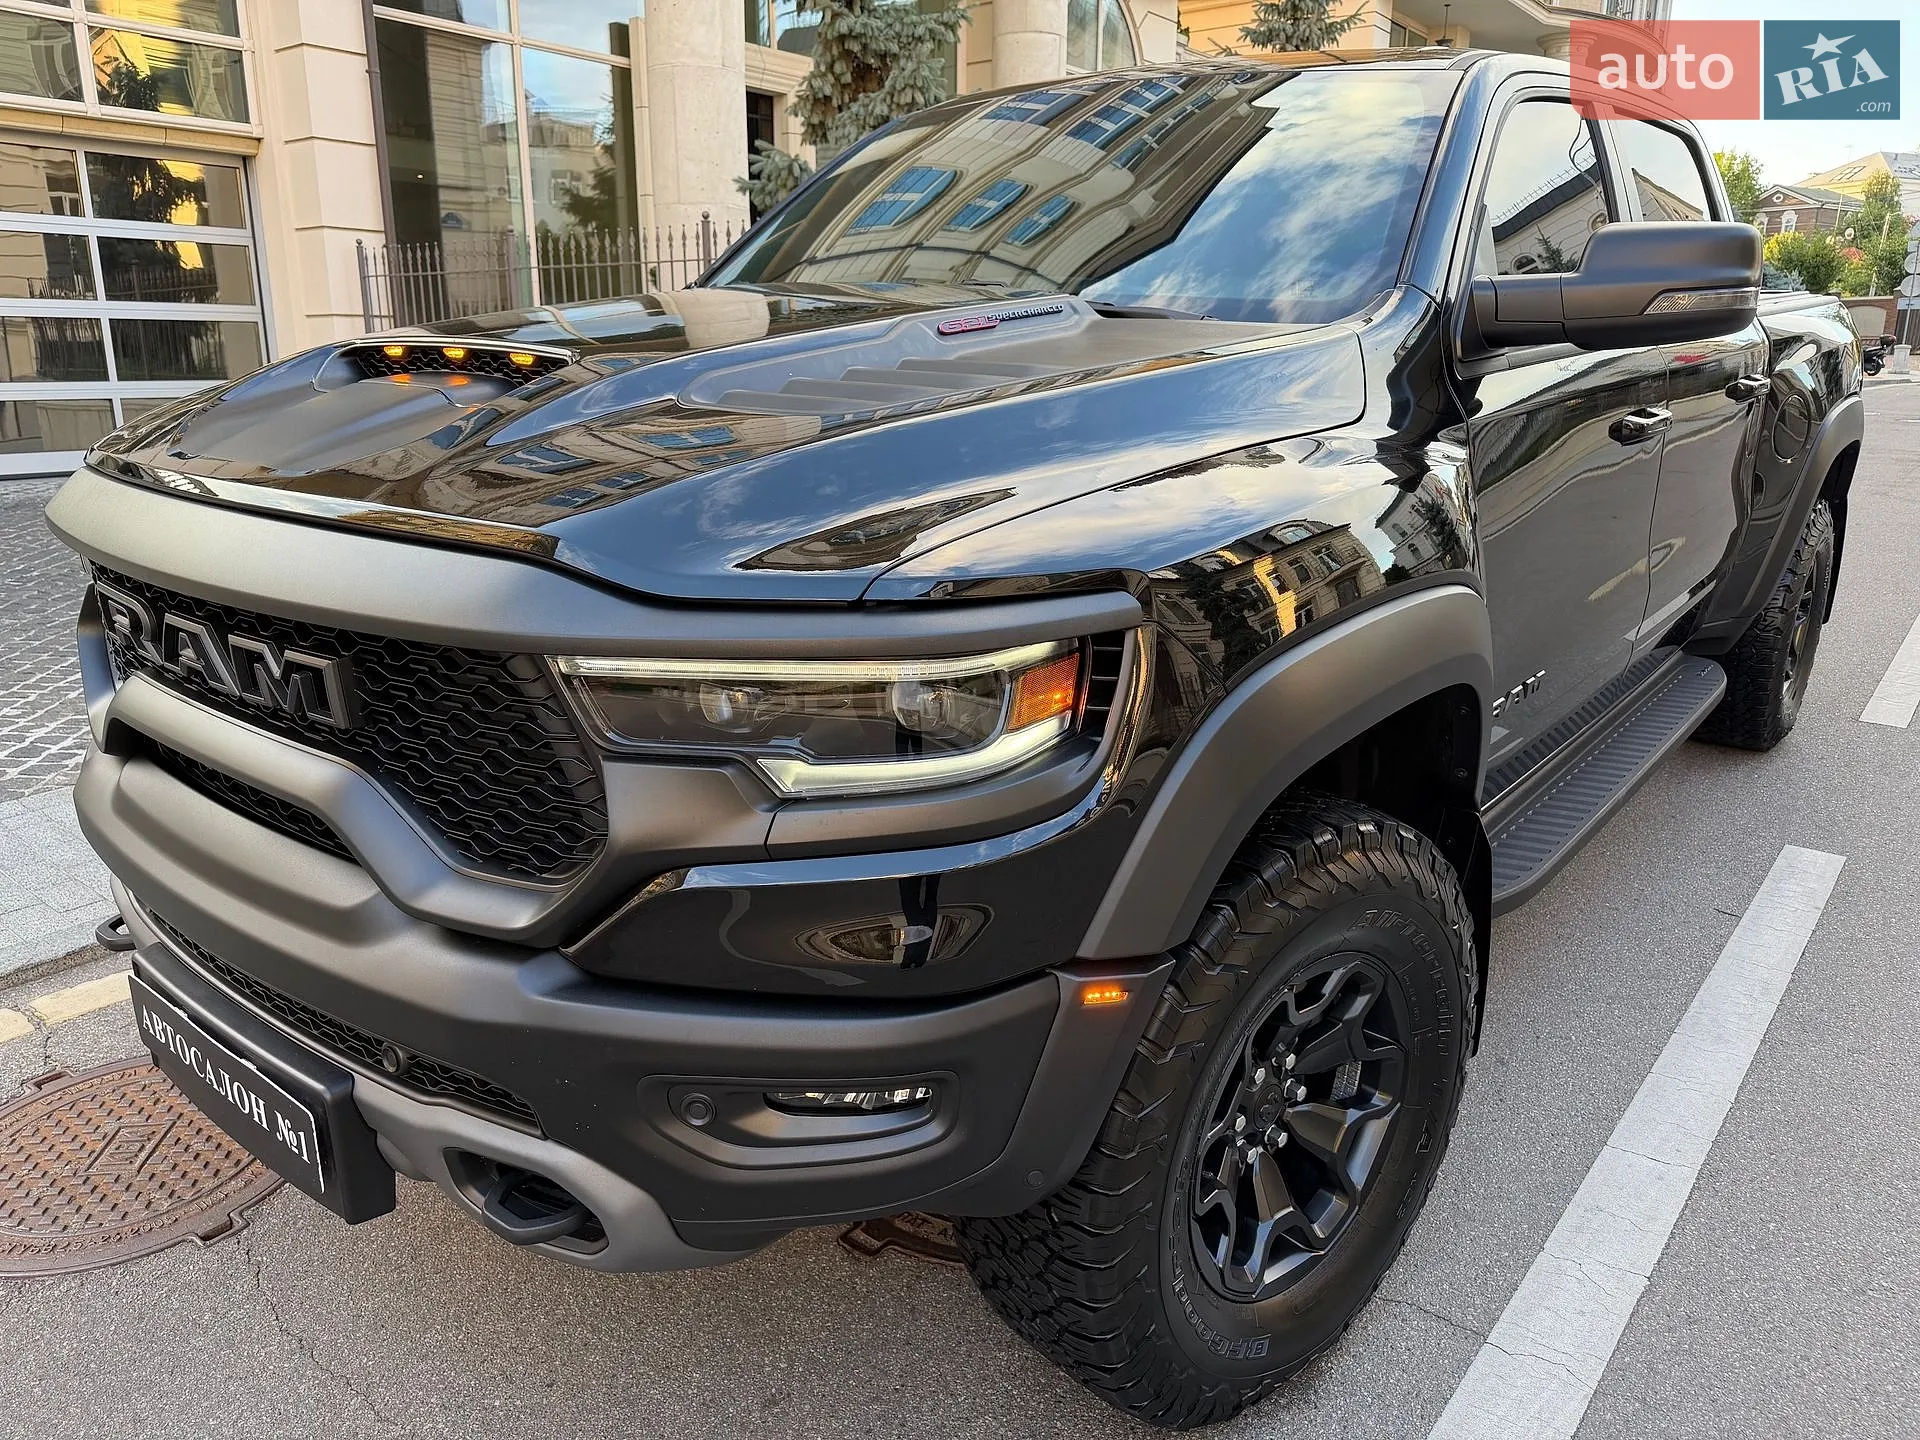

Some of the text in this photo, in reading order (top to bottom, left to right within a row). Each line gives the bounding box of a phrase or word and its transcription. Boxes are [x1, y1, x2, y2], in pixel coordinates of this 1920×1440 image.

[988, 304, 1064, 321] SUPERCHARGED
[95, 580, 351, 729] RAM
[142, 1004, 311, 1164] АВТОСАЛОН №1
